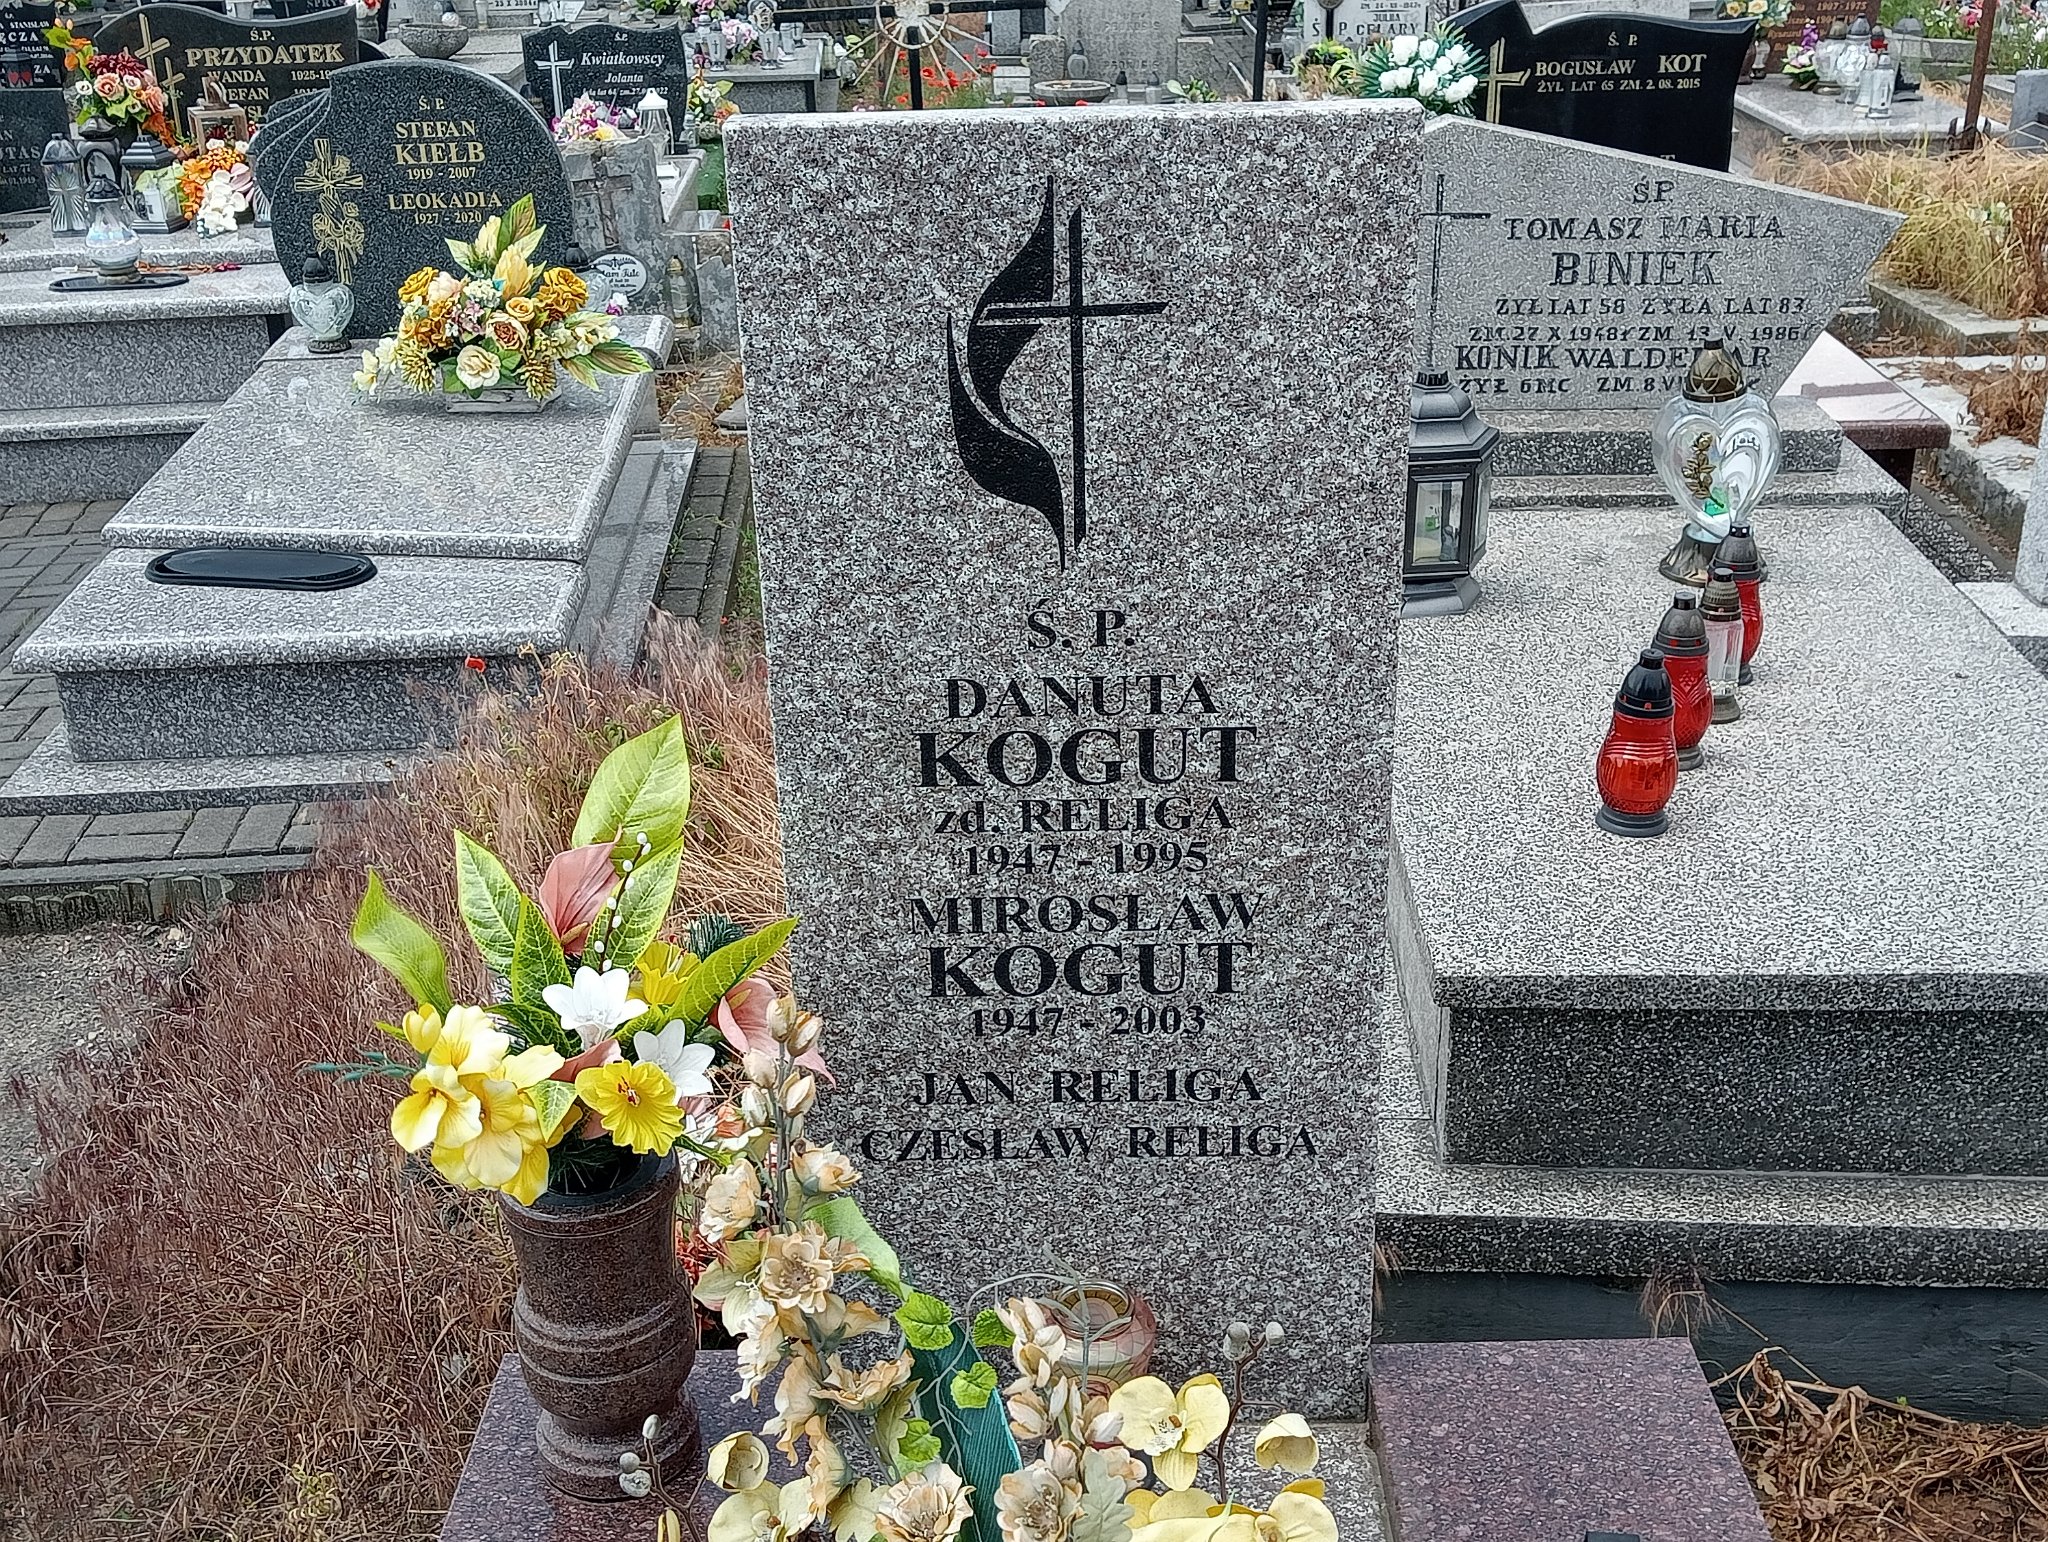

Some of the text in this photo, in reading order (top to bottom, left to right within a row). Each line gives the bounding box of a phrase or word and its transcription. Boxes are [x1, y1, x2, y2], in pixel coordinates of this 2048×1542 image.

[249, 27, 276, 41] Ś.P.
[1339, 22, 1348, 36] P
[185, 43, 345, 68] PRZYDATEK
[580, 51, 665, 67] Kwiatkowscy
[1657, 54, 1708, 74] KOT
[207, 69, 331, 83] WANDA 1925-19
[604, 73, 644, 84] Jolanta
[1571, 80, 1597, 92] LAT
[1601, 80, 1614, 92] 65
[1619, 79, 1643, 91] ZM.
[1676, 78, 1701, 90] 2015
[228, 87, 270, 101] EFAN
[418, 95, 445, 110] Ś. P.
[394, 120, 477, 139] STEFAN
[392, 141, 486, 165] KIEŁB
[407, 168, 434, 180] 1919
[448, 167, 477, 179] 2007
[387, 191, 503, 210] LEOKADIA
[414, 212, 439, 225] 1927
[454, 211, 482, 223] 2020
[1504, 215, 1786, 241] TOMASZ MARIA
[1550, 250, 1724, 287] BINIEK
[1548, 298, 1593, 316] LAT
[1723, 296, 1773, 315] LAT
[1453, 344, 1773, 370] KONIK WALDEAR
[1091, 609, 1136, 648] P.
[945, 674, 1220, 719] DANUTA
[912, 726, 1257, 788] KOGUT
[935, 797, 1237, 834] zd. RELIGA
[967, 844, 1062, 876] 1947
[1111, 842, 1209, 874] 1995
[922, 941, 1253, 998] KOGUT
[969, 1007, 1064, 1037] 1947
[1110, 1006, 1207, 1036] 2003
[913, 1068, 1265, 1105] JAN RELIGA
[1126, 1123, 1319, 1158] RELIGA
